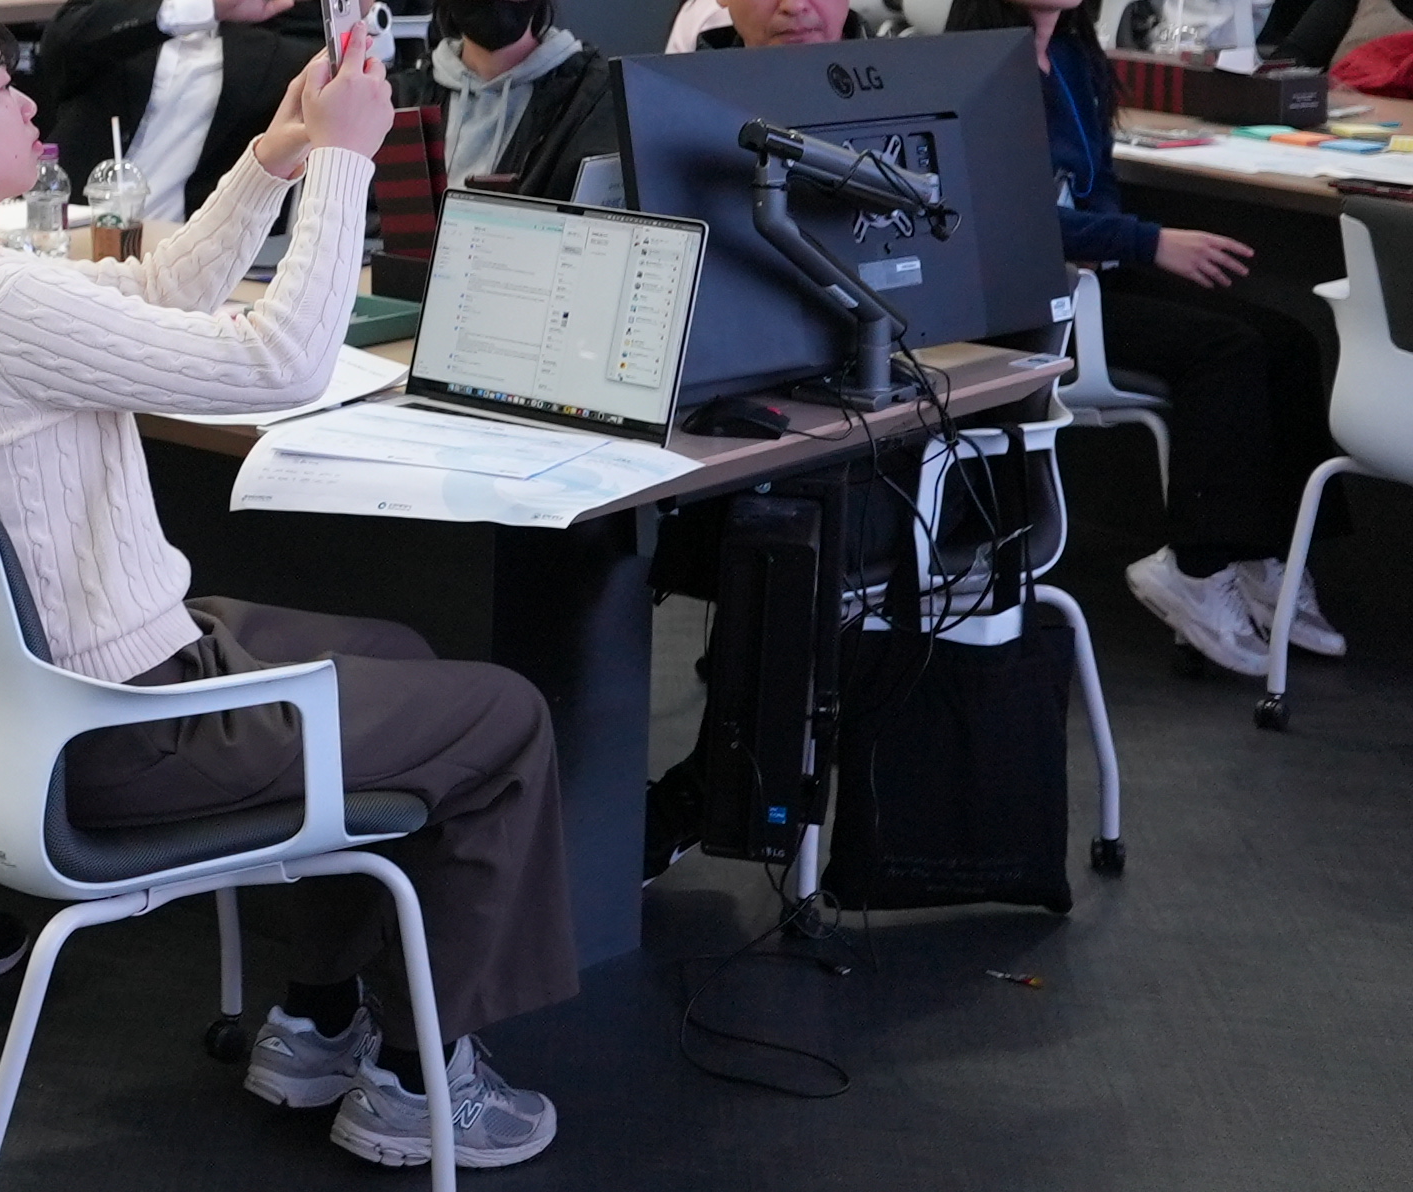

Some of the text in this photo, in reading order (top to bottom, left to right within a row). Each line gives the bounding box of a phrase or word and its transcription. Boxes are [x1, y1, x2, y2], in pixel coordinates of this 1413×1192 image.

[853, 66, 885, 91] LG
[355, 1032, 377, 1058] N
[452, 1099, 484, 1129] N
